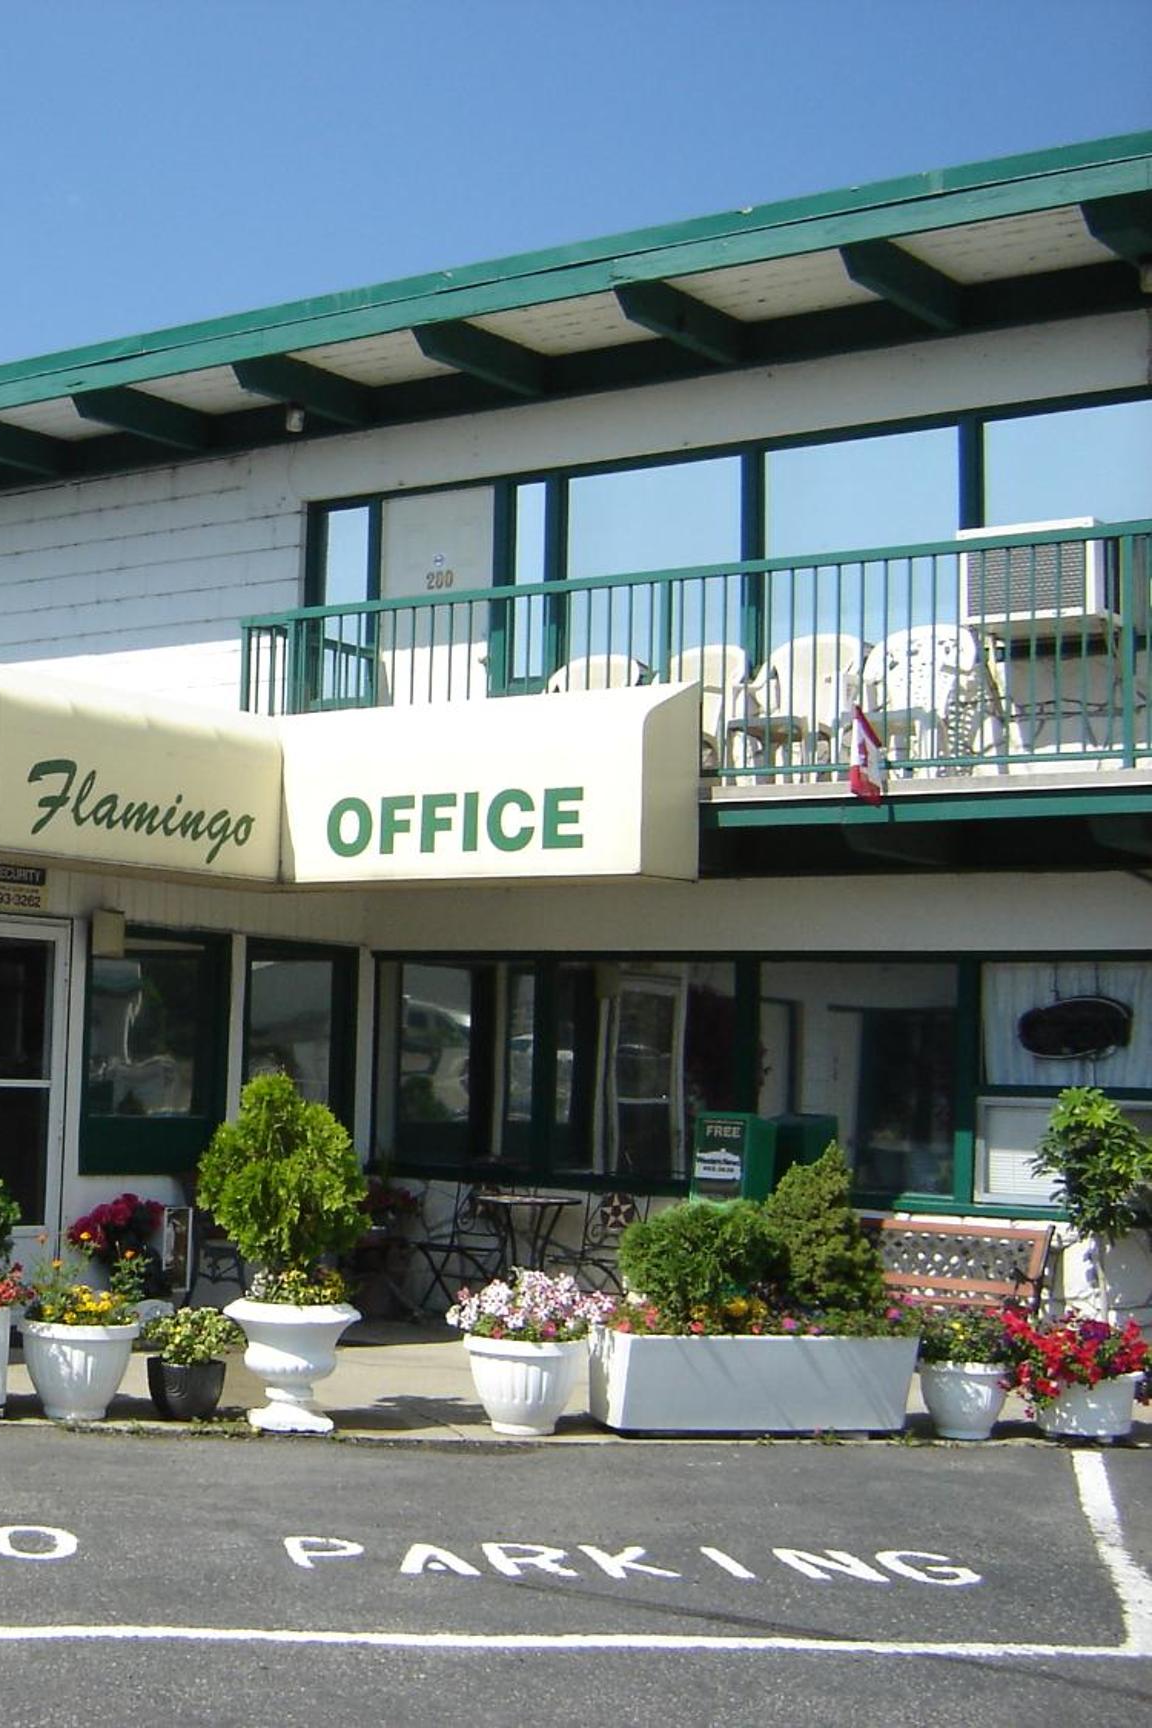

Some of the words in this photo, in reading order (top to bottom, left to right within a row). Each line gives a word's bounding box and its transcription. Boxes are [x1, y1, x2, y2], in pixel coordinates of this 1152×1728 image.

[426, 569, 454, 590] 200
[27, 759, 255, 864] Flamingo
[327, 786, 584, 857] OFFICE
[706, 1125, 741, 1138] FREE
[283, 1536, 982, 1586] PARKING
